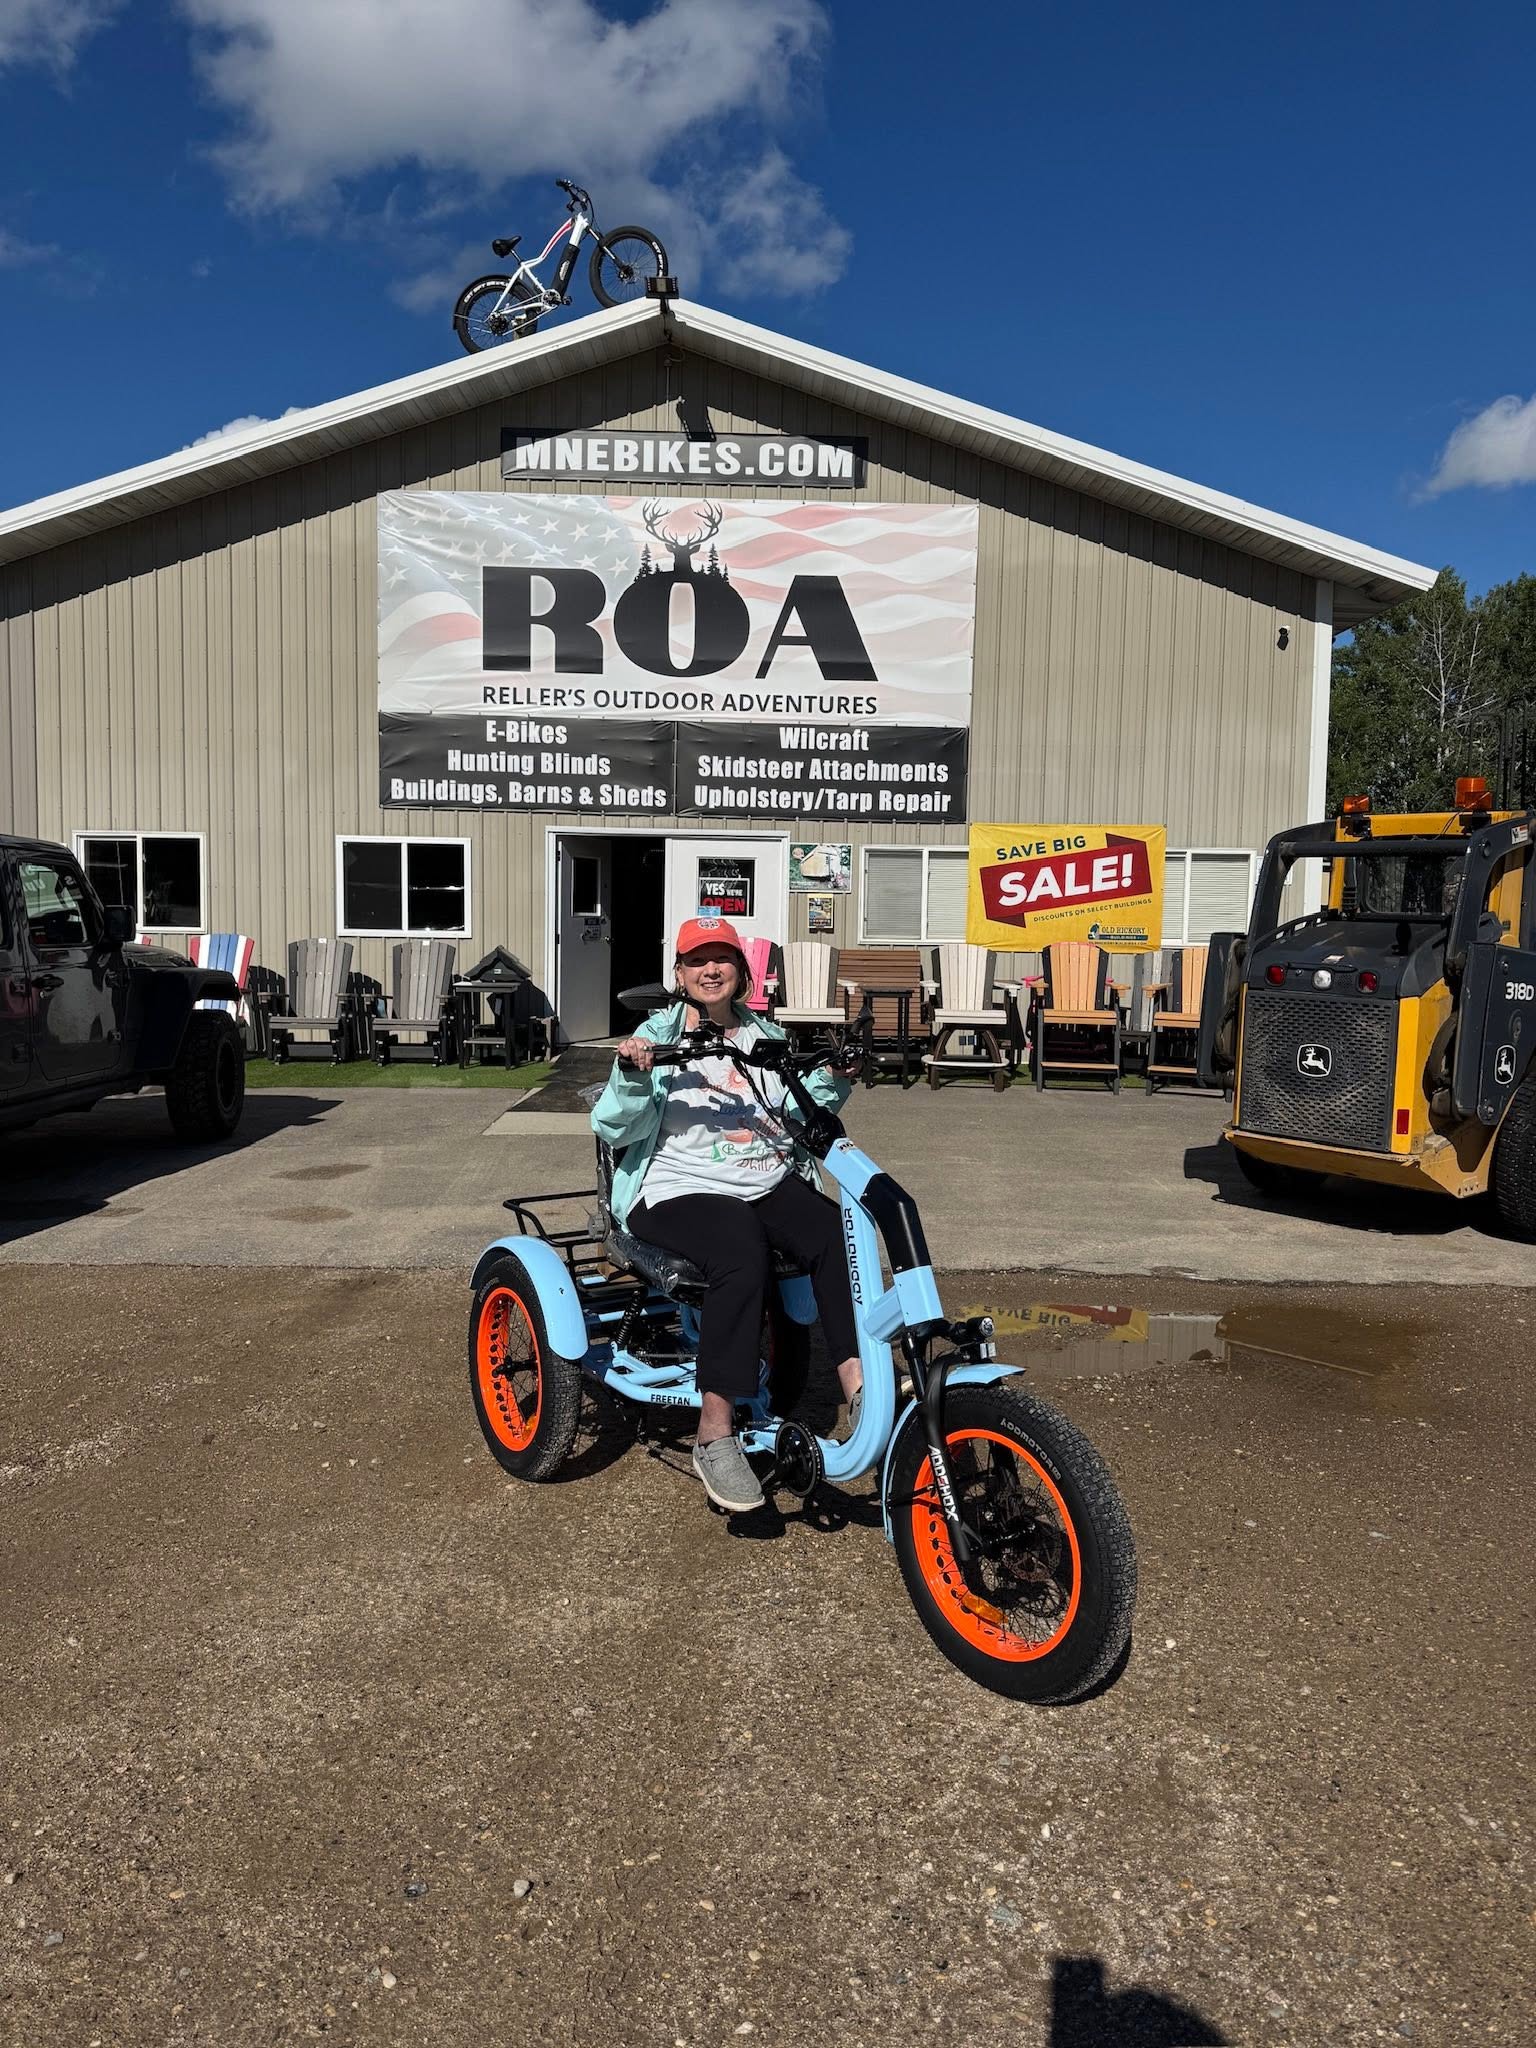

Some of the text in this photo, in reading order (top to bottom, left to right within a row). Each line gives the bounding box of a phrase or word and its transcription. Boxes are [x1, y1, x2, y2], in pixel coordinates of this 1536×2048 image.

[515, 437, 854, 478] MNEBIKES.COM
[482, 565, 879, 682] ROA
[483, 686, 878, 715] RELLER'S OUTDOOR ADVENTURES
[486, 719, 568, 745] E-Bikes
[779, 726, 870, 751] Wilcraft
[447, 749, 612, 776] Hunting Blinds
[698, 754, 949, 783] Skidsteer Attachments
[390, 777, 667, 808] Buildings, Barns & Sheds
[694, 784, 952, 813] Upholstery/Tarp Repair
[996, 835, 1087, 861] SAVE BIG
[705, 882, 725, 896] YES
[998, 853, 1134, 907] SALE!
[1033, 898, 1152, 922] DISCOUNTS ON SELECT BUILDINGS
[1505, 981, 1535, 1001] 318D
[844, 1207, 863, 1306] ADDMOTOR
[650, 1393, 691, 1406] FREETAN
[1000, 1418, 1054, 1470] ADDMOTOR
